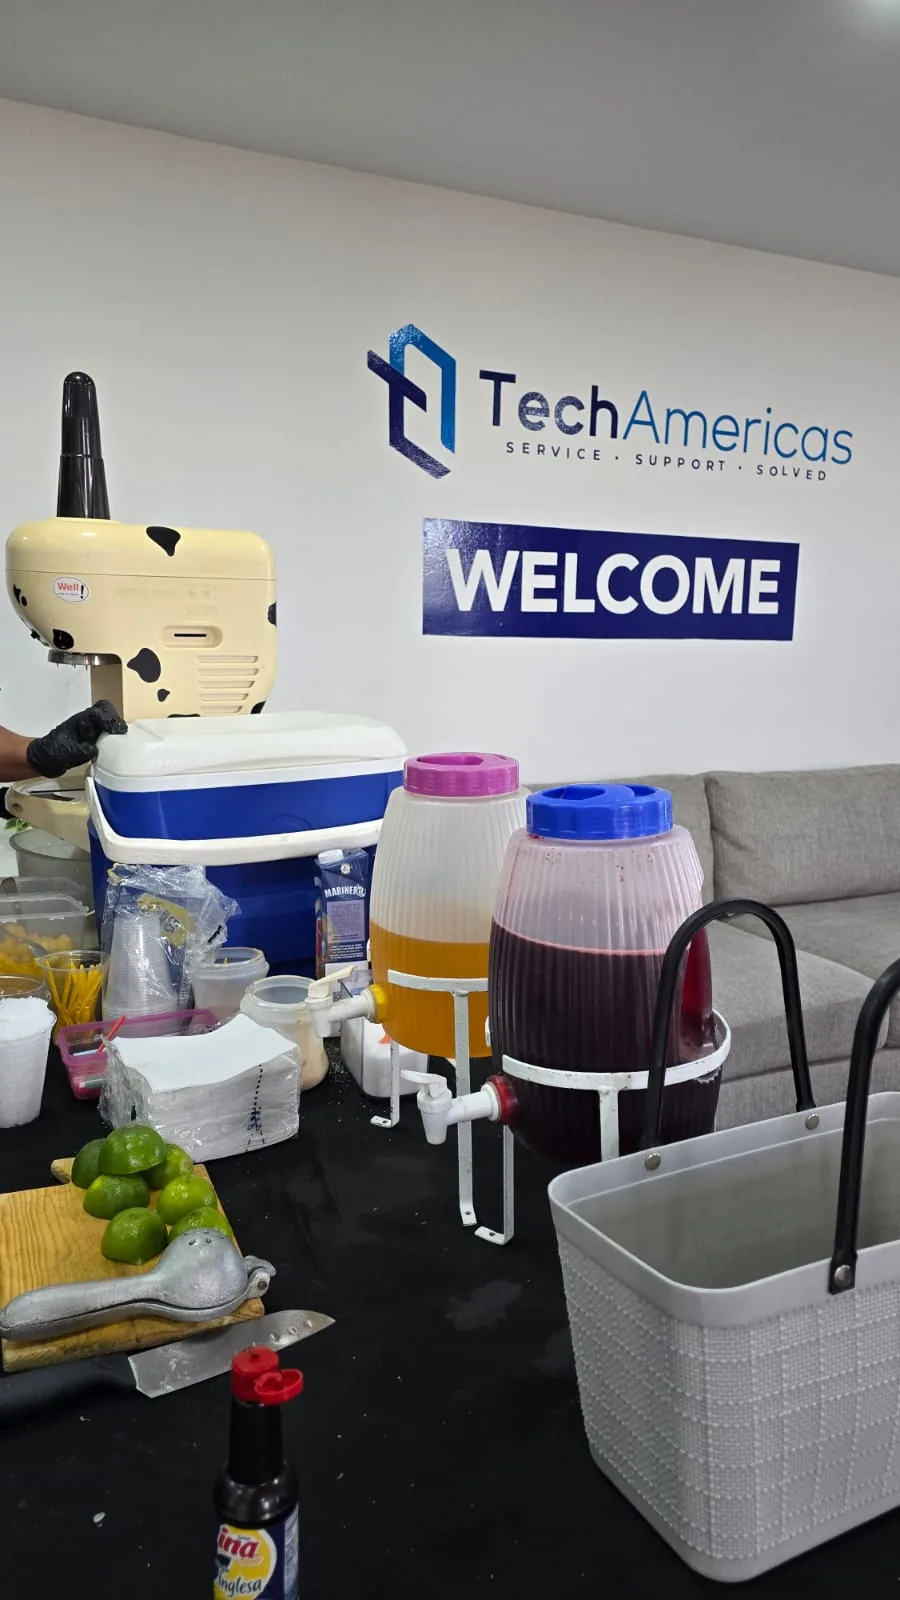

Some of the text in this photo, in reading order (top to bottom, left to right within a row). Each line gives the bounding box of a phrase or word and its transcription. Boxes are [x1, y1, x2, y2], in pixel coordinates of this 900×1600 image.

[479, 369, 853, 464] TechAmericas
[506, 441, 826, 480] SERVICE SUPPORT SOLVED
[446, 549, 781, 615] WELCOME
[219, 1574, 261, 1597] Inglesa
